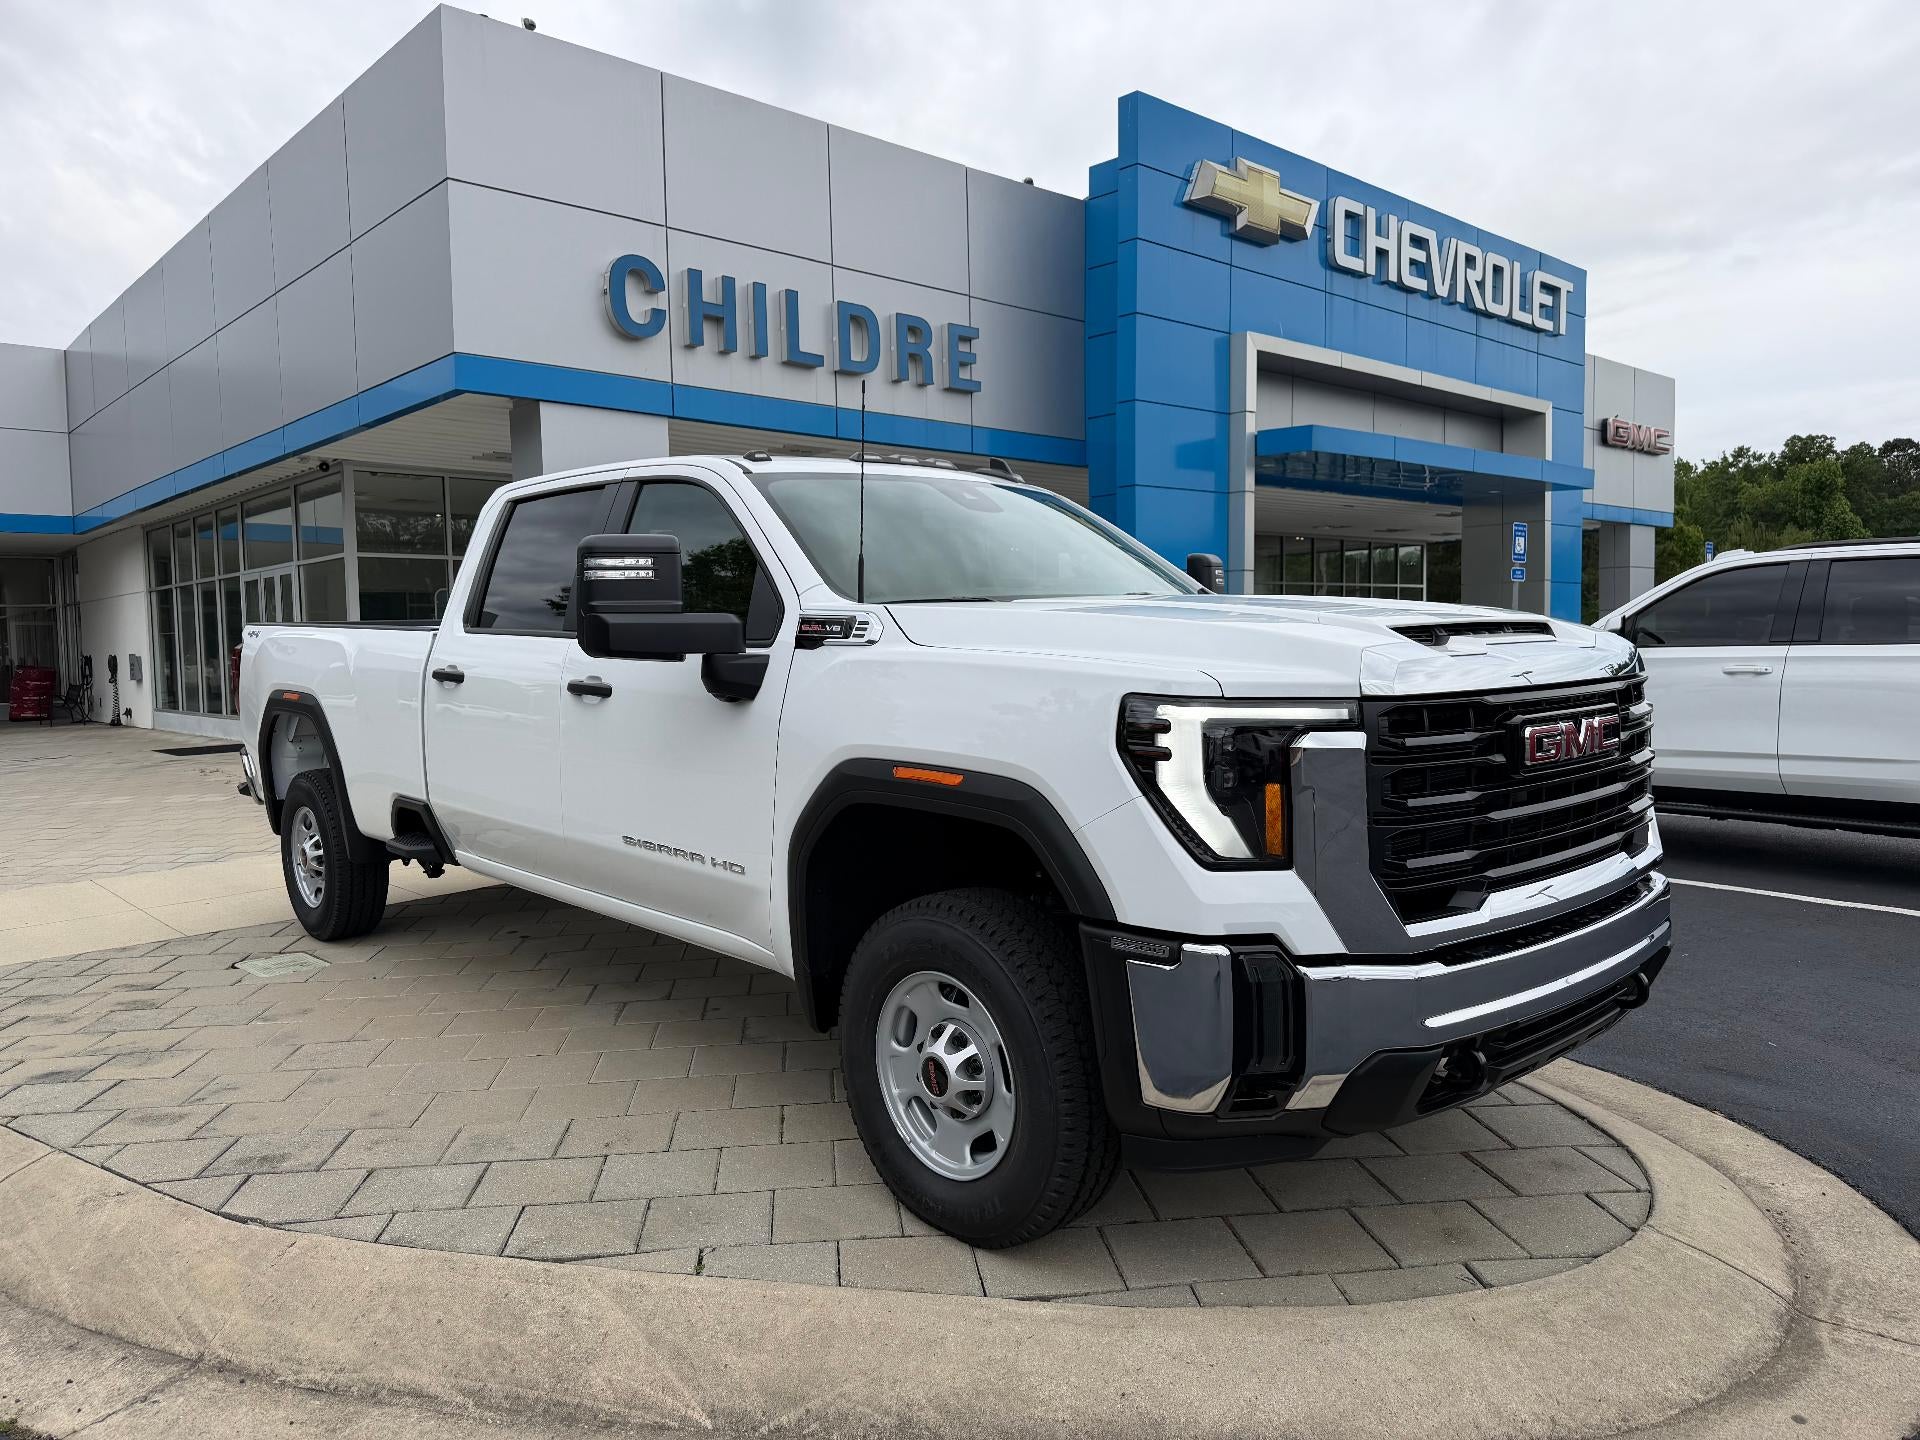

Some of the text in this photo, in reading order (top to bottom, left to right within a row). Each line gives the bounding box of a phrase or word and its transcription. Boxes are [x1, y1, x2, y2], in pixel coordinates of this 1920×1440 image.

[1328, 195, 1574, 336] CHEVROLET
[604, 254, 981, 393] CHILDRE
[1606, 418, 1671, 455] GMC
[1524, 714, 1620, 765] GMC
[621, 835, 745, 876] SIERRA HD
